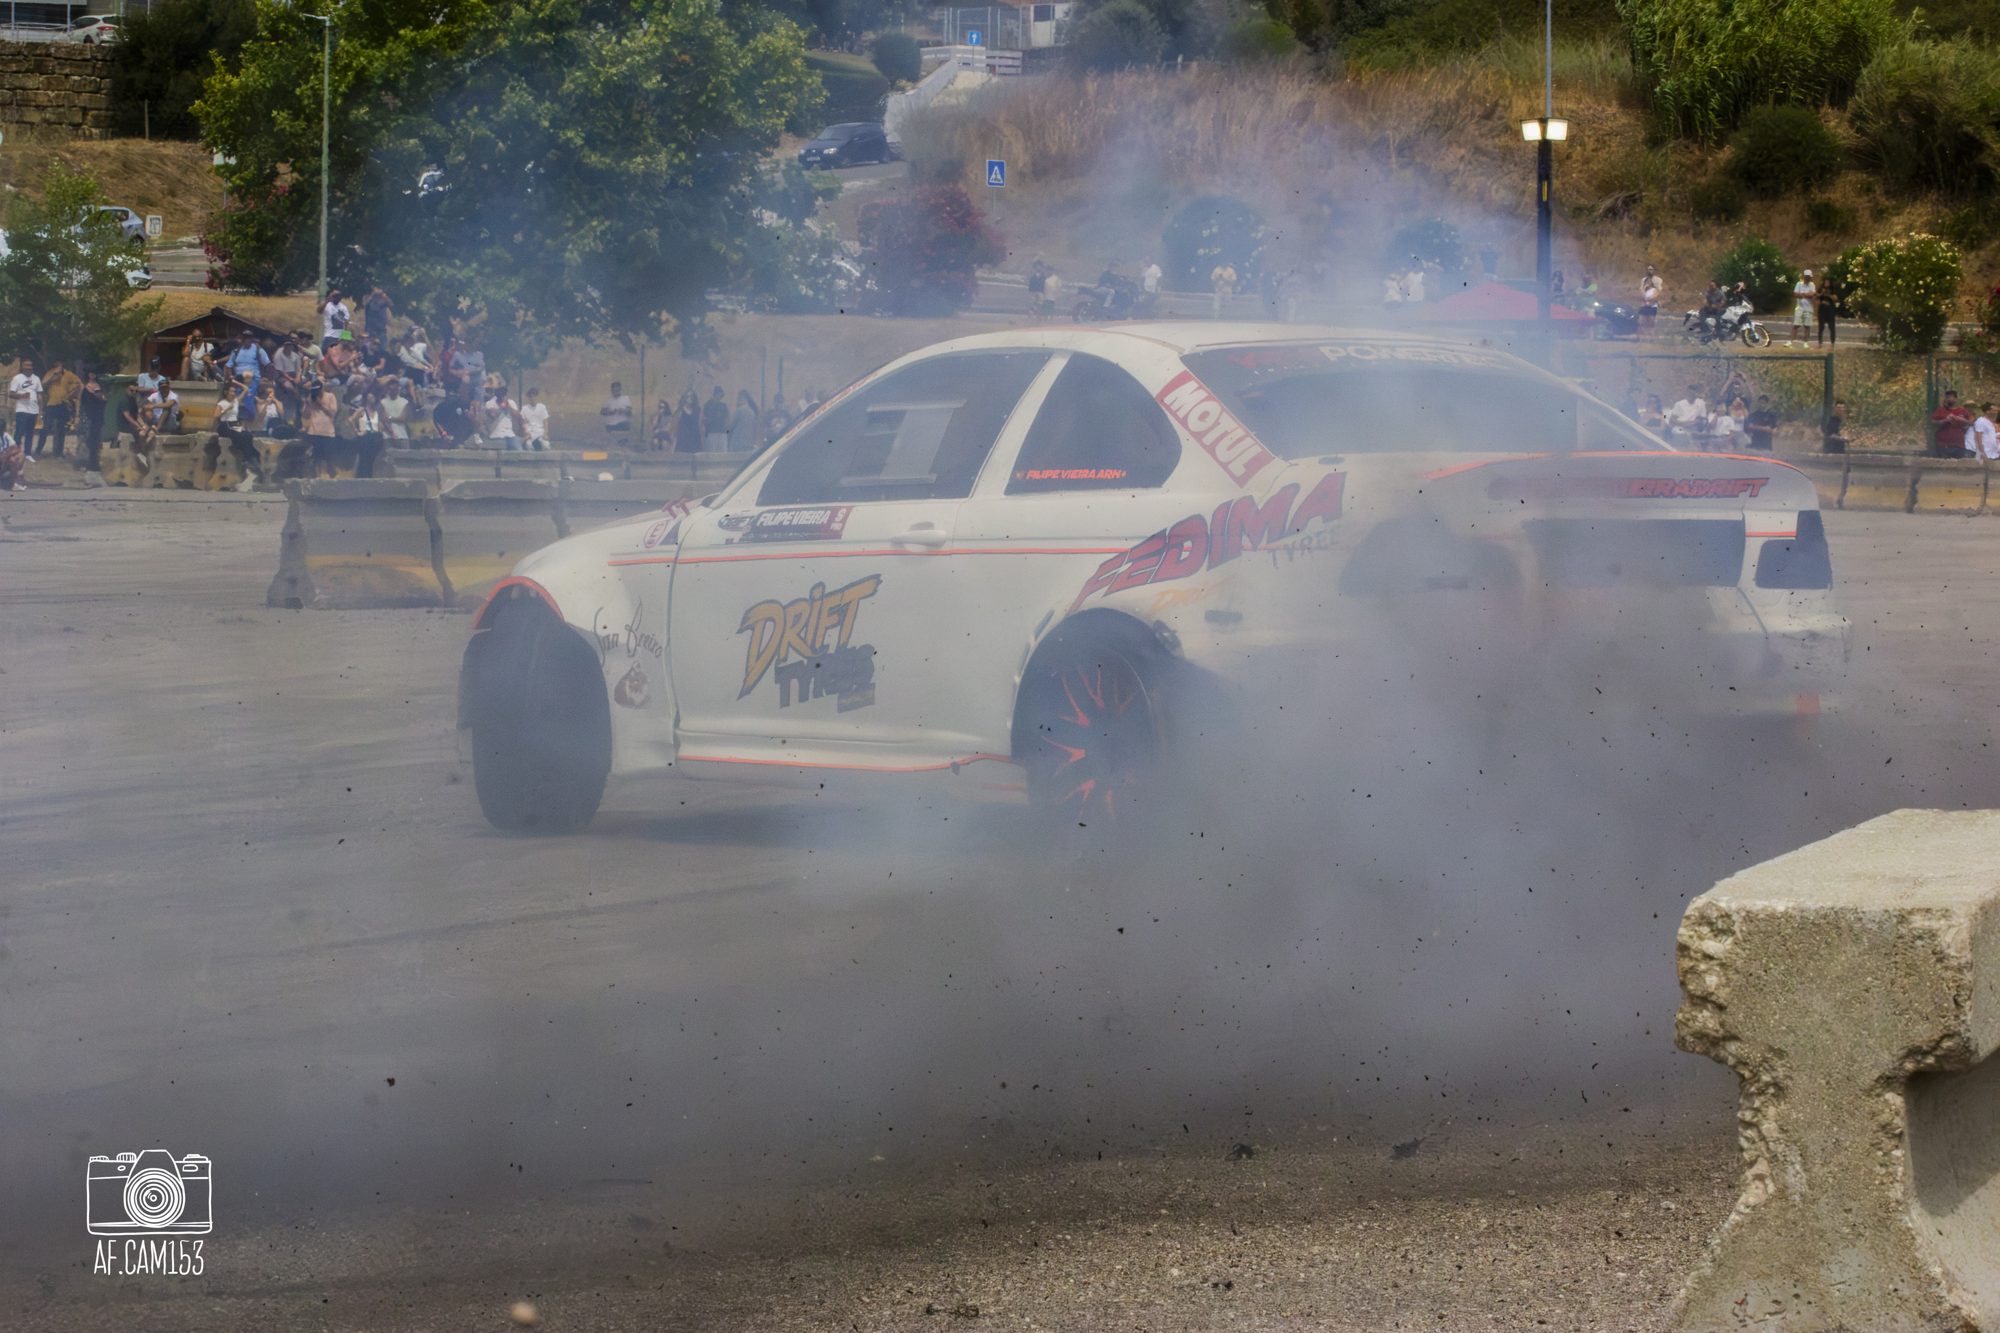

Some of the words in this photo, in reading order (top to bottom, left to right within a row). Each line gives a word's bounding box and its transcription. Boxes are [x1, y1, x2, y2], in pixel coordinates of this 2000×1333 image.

[1026, 469, 1060, 479] FILIPE
[1061, 469, 1096, 479] VIEIRA
[1163, 380, 1262, 478] MOTUL
[757, 511, 794, 526] FILIPE
[792, 510, 831, 525] VIEIRA
[1064, 471, 1347, 616] FEDIMA
[736, 573, 883, 701] DRIFT
